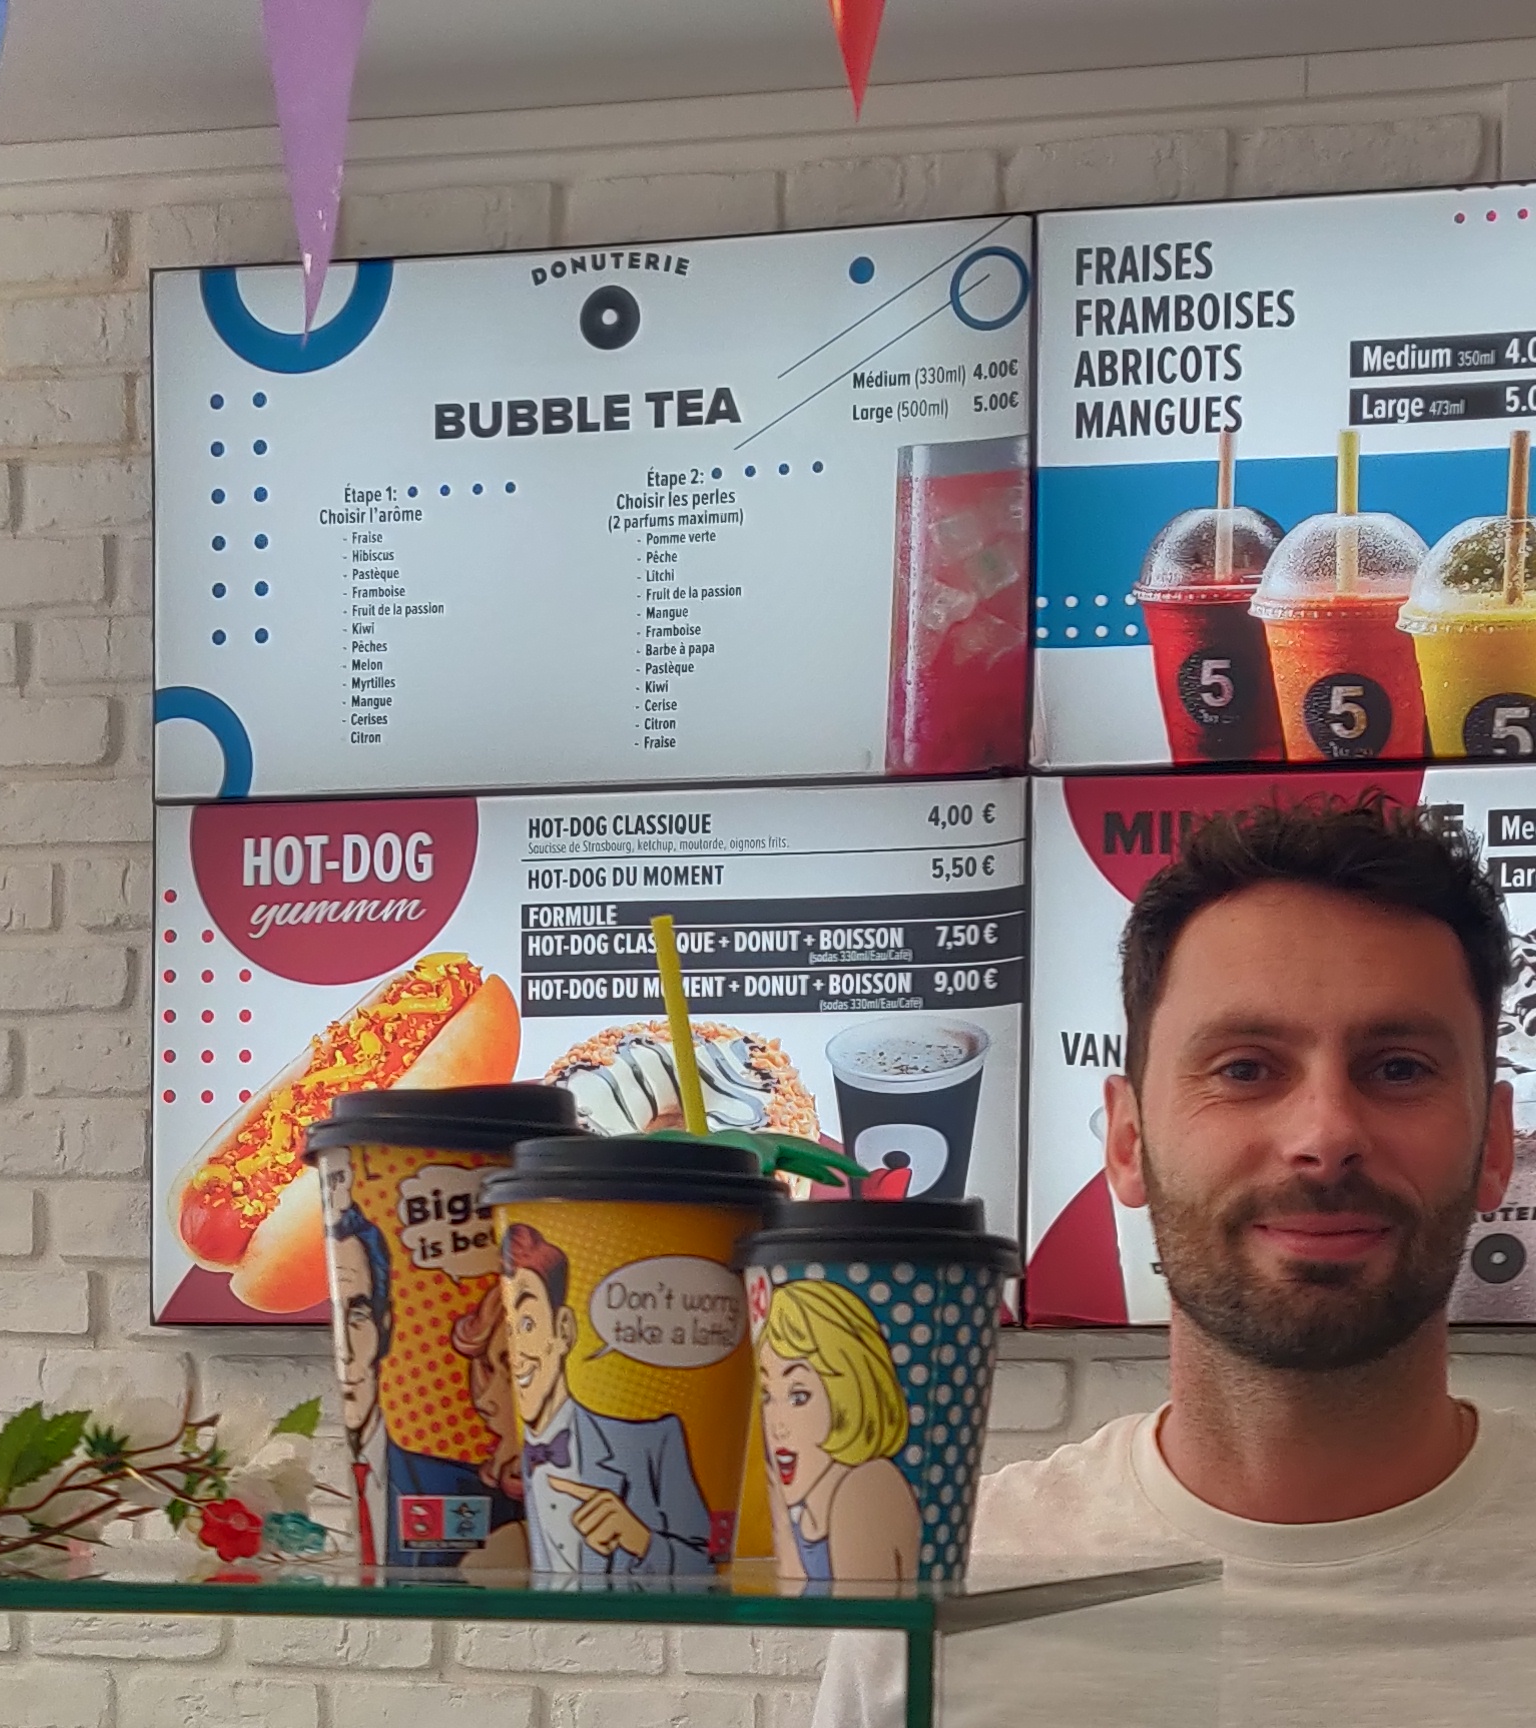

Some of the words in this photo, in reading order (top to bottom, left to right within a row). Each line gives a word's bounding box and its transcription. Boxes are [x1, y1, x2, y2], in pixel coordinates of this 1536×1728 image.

[530, 252, 690, 286] DONUTERIE
[1075, 240, 1214, 286] FRAISES
[1075, 289, 1296, 337] FRAMBOISES
[1075, 343, 1242, 389] ABRICOTS
[1361, 343, 1451, 373] Medium
[1457, 347, 1495, 368] 350ml
[852, 368, 911, 389] Médium
[915, 364, 966, 389] (330ml)
[973, 359, 1019, 381] 4.00€
[434, 393, 630, 440] BUBBLE
[645, 387, 741, 429] TEA
[852, 402, 893, 423] Large
[897, 399, 948, 421] (500ml)
[973, 391, 1019, 414] 5.00€
[1075, 394, 1242, 440] MANGUES
[1361, 391, 1424, 423] Large
[1428, 396, 1466, 418] 473ml
[647, 466, 686, 489] Étape
[690, 469, 704, 484] 2:
[344, 483, 382, 506] Étape
[385, 486, 397, 502] 1:
[616, 492, 665, 510] Choisir
[668, 491, 688, 507] les
[692, 489, 736, 509] perles
[319, 508, 366, 525] Choisir
[369, 506, 422, 523] l'arôme
[352, 532, 383, 544] Fraise
[352, 550, 394, 562] Hibiscus
[352, 567, 400, 581] Pastèque
[352, 586, 405, 598] Framboise
[352, 604, 375, 616] Fruit
[378, 604, 390, 615] de
[393, 603, 402, 615] la
[405, 602, 444, 618] passion
[352, 622, 374, 635] Kiwi
[352, 640, 387, 653] Pêches
[352, 677, 396, 692] Myrtilles
[352, 695, 392, 709] Mangue
[528, 815, 607, 839] HOT-DOG
[612, 814, 712, 837] CLASSIQUE
[928, 805, 972, 829] 4,00
[983, 803, 996, 824] €
[528, 841, 566, 855] Saucisse
[569, 841, 580, 853] de
[583, 839, 634, 855] Strasbourg,
[637, 837, 676, 853] ketchup,
[679, 838, 726, 852] moutarde,
[729, 837, 766, 851] oignons
[769, 836, 789, 850] frits.
[241, 831, 434, 887] HOT-DOG
[528, 905, 617, 927] FORMULE
[606, 1281, 674, 1311] Don't
[615, 1319, 661, 1346] take
[671, 1327, 685, 1345] a
